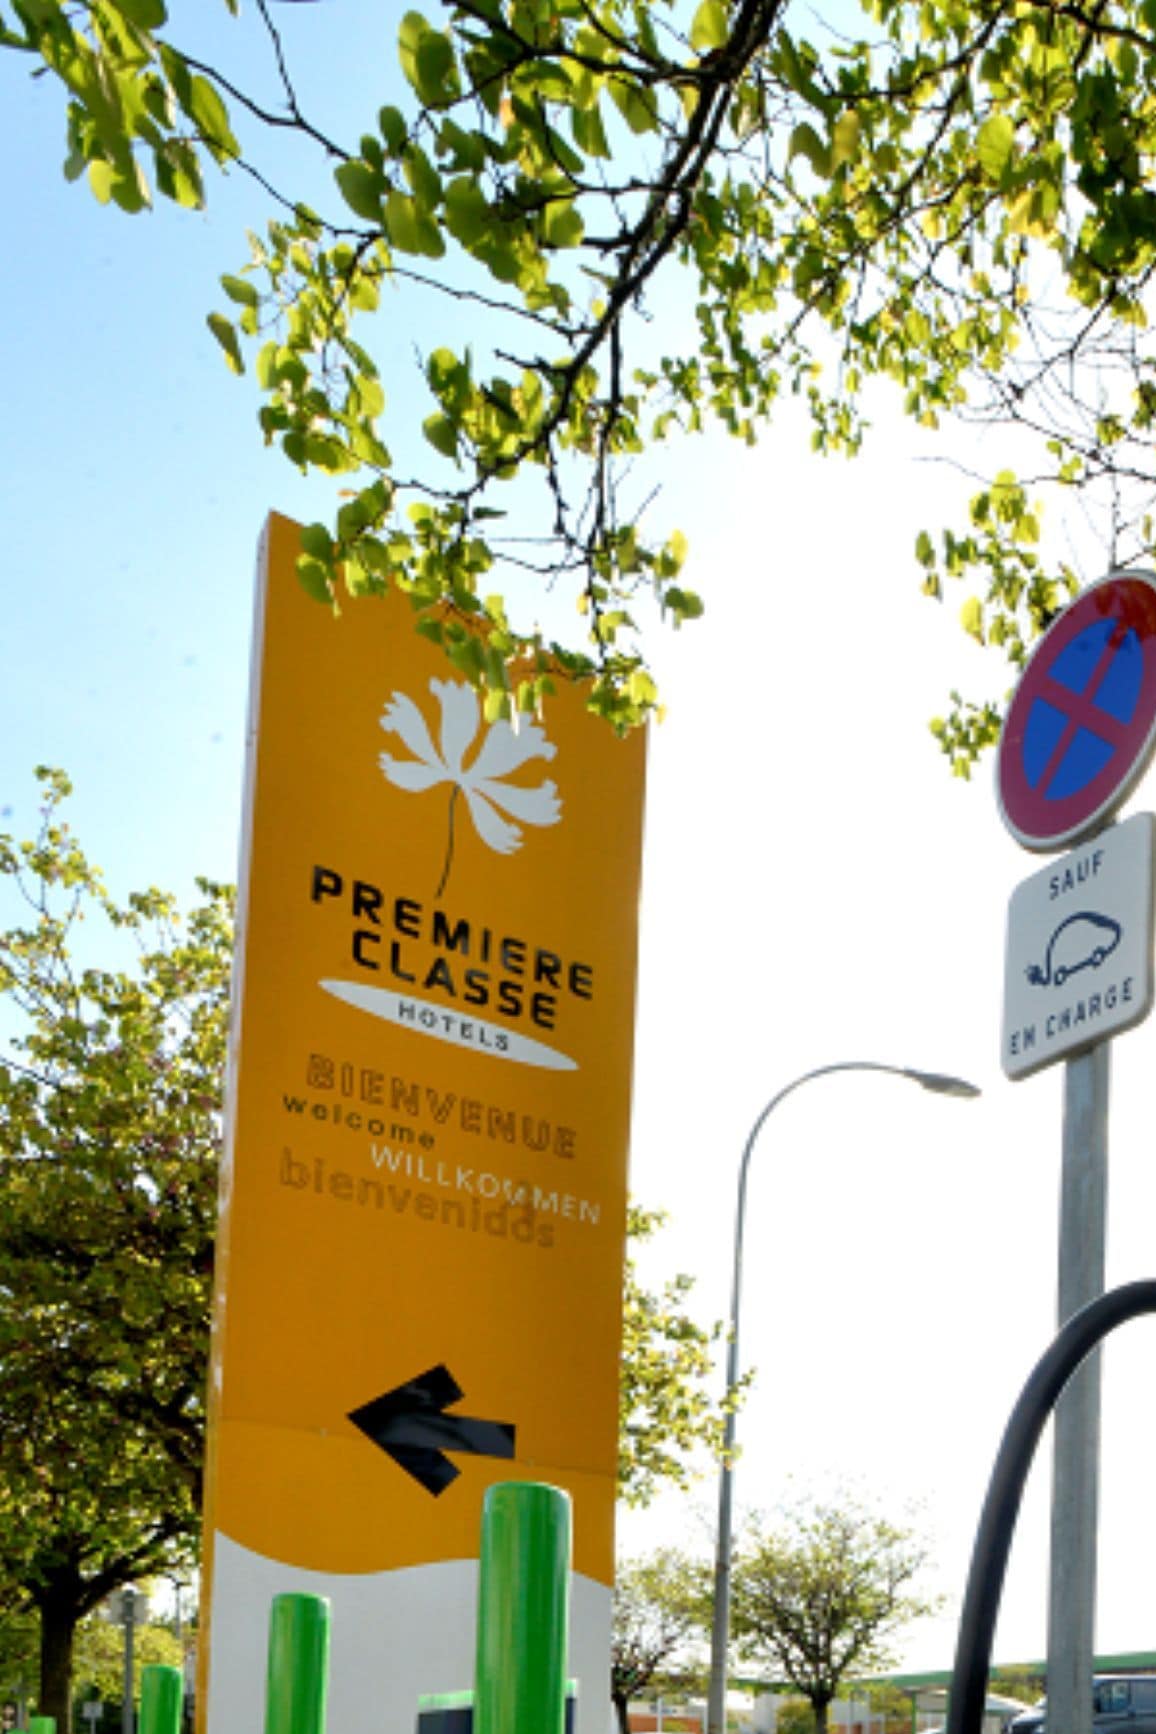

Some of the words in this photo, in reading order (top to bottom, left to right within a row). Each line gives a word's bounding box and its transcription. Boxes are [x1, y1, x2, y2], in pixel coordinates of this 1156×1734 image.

[1048, 848, 1105, 901] SAUF
[311, 865, 593, 1000] PREMIERE
[352, 929, 557, 1030] CLASSE
[1009, 1020, 1037, 1056] EN
[1045, 976, 1134, 1039] CHARGE
[398, 1001, 509, 1051] HOTELS
[283, 1094, 436, 1150] welcome
[306, 1053, 577, 1159] BIENVENUE
[370, 1143, 600, 1225] WILLKOMMEN
